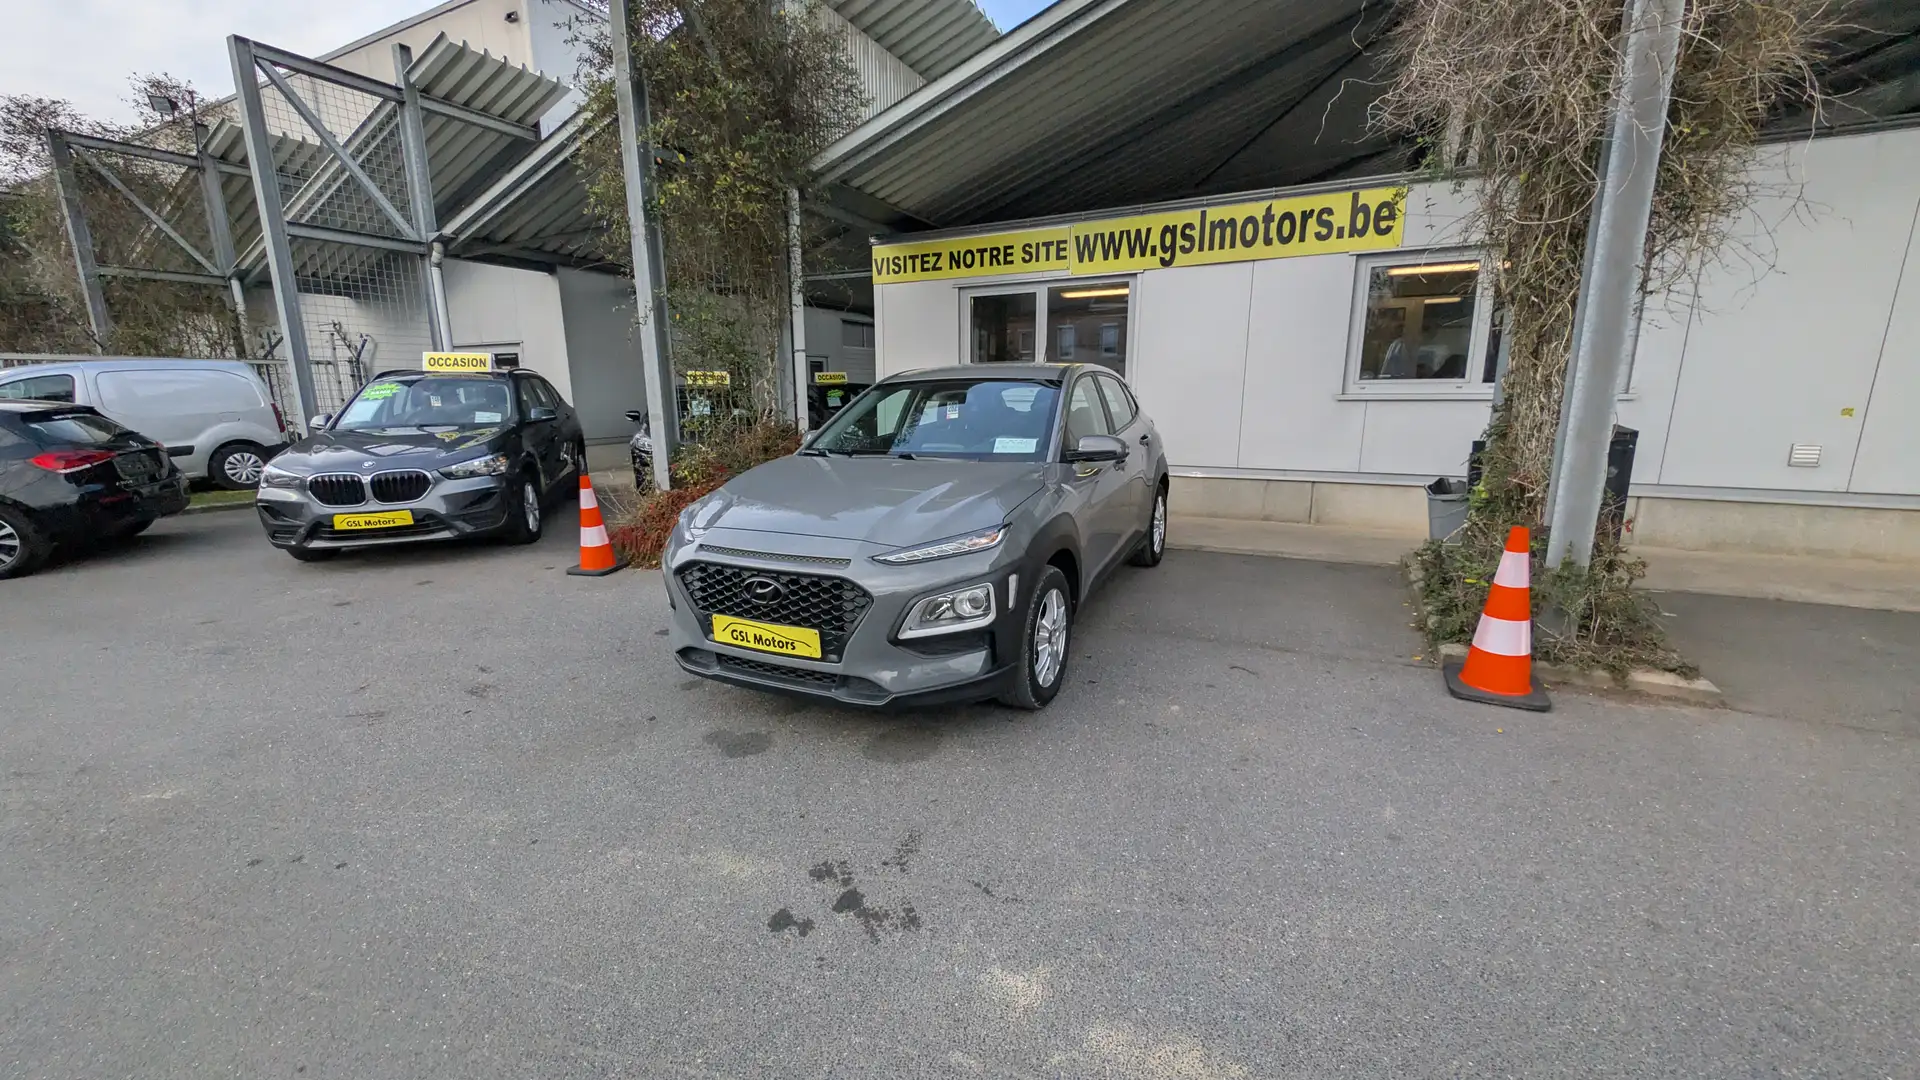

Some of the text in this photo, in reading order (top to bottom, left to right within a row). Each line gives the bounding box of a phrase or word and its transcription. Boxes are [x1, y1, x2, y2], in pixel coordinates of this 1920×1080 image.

[873, 191, 1397, 276] VISITEZ NOTRE SITE www.gslmotors.be
[428, 356, 487, 368] OCCASION
[817, 373, 846, 381] OCCASION
[346, 518, 397, 528] GSL Motors
[730, 629, 797, 651] GSL Motors
